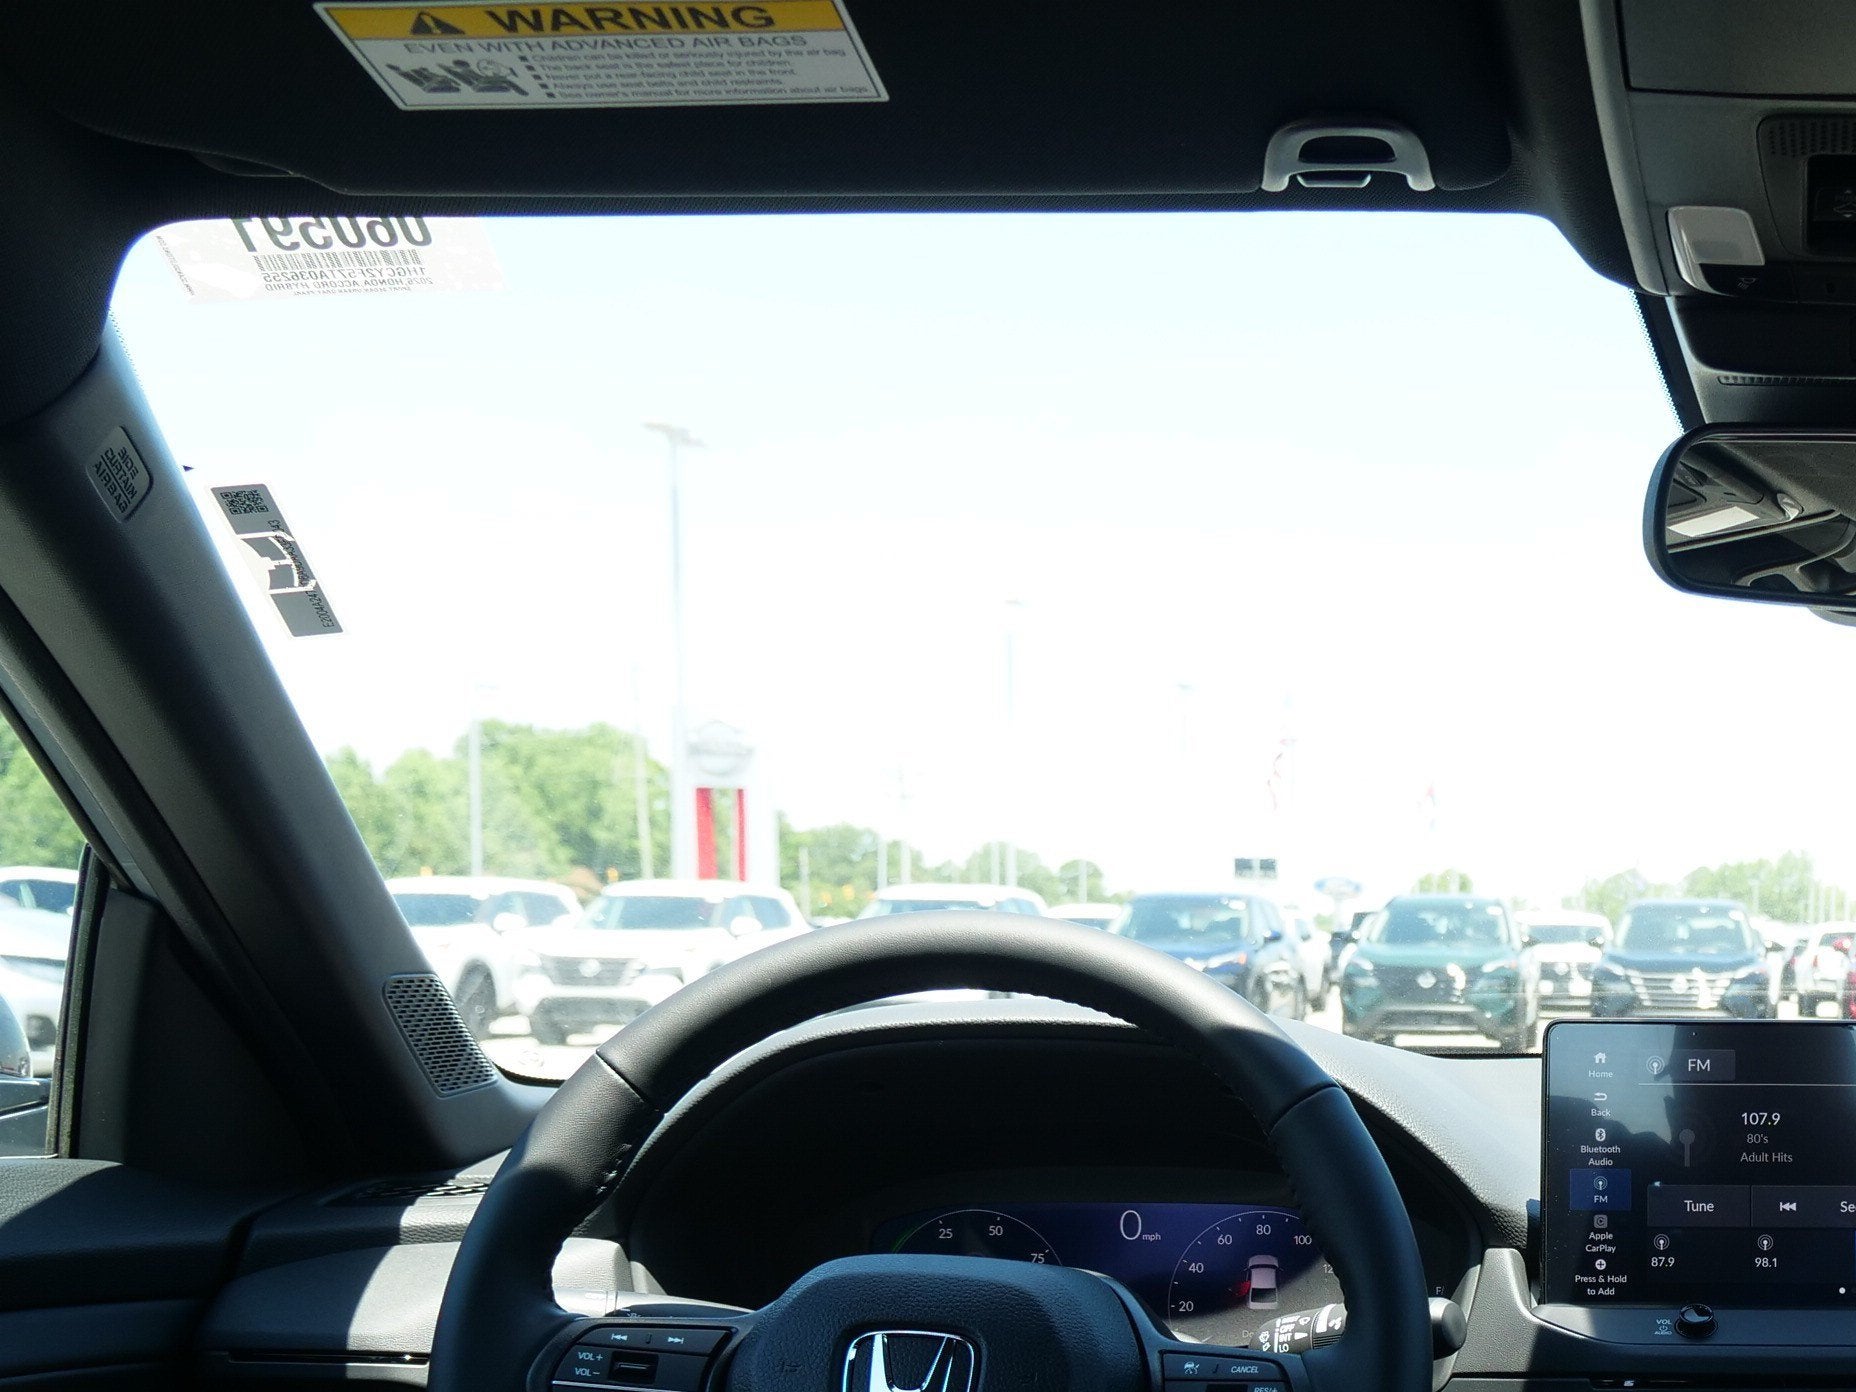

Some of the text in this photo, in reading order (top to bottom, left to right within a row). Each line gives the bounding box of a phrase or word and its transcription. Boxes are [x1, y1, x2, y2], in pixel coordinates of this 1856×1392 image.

[486, 5, 775, 33] WARNING
[404, 36, 807, 53] EVEN WITH ADVANCED AIR BAGS
[1688, 1059, 1710, 1072] FM
[1588, 1069, 1613, 1078] Home
[1591, 1108, 1611, 1117] Back
[1741, 1112, 1780, 1126] 107.9
[1747, 1133, 1769, 1144] 80's
[1580, 1145, 1621, 1154] Bluetooth
[1588, 1157, 1613, 1167] Audio
[1740, 1152, 1793, 1163] Adult Hits
[1593, 1195, 1608, 1203] FM
[1684, 1201, 1714, 1213] Tune
[988, 1225, 1003, 1236] 50
[1119, 1210, 1161, 1243] 0 mph
[1256, 1225, 1271, 1236] 80
[939, 1228, 953, 1239] 25
[1589, 1231, 1613, 1241] Apple
[1217, 1234, 1232, 1245] 60
[1293, 1235, 1312, 1246] 100
[1585, 1244, 1616, 1254] CarPlay
[1030, 1253, 1045, 1263] 75
[1651, 1257, 1675, 1268] 87.9
[1754, 1258, 1778, 1269] 98.1
[1189, 1263, 1204, 1274] 40
[1575, 1274, 1627, 1284] Press Hold
[1587, 1287, 1615, 1296] to Add
[1179, 1301, 1194, 1312] 20
[1279, 1324, 1296, 1333] OFF
[1279, 1333, 1292, 1342] INT
[1279, 1343, 1289, 1353] LO
[1230, 1366, 1259, 1374] CANCEL
